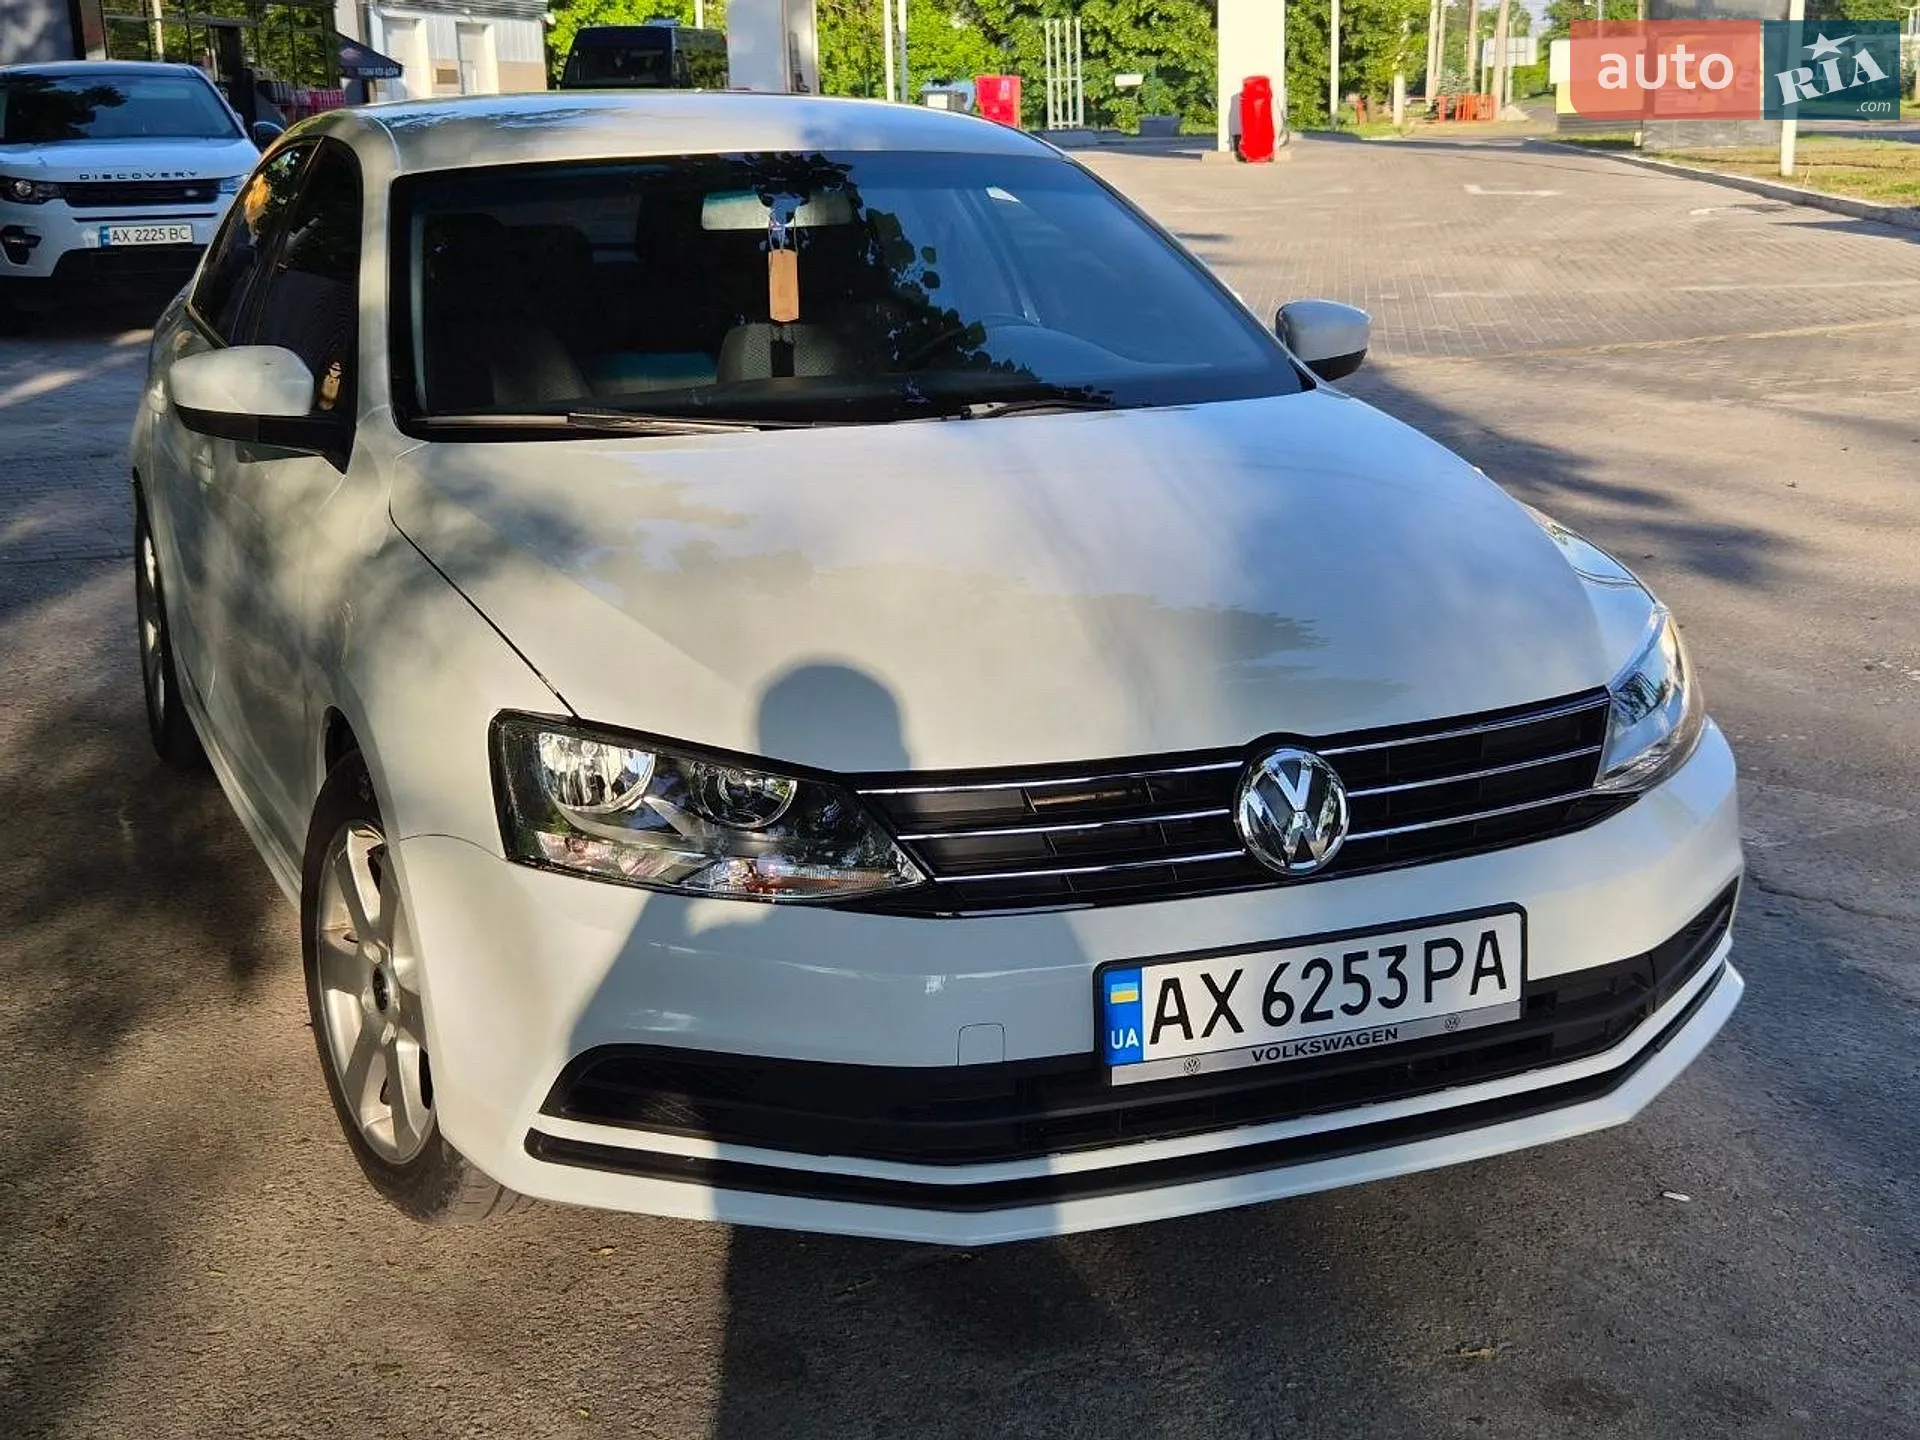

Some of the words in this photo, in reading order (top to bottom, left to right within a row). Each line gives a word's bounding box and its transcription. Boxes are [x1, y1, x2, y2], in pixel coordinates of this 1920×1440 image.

[79, 171, 198, 180] DISCOVERY
[112, 230, 130, 243] AX
[135, 229, 166, 242] 2225
[170, 228, 189, 240] BC
[1149, 968, 1245, 1045] AX
[1261, 944, 1409, 1027] 6253
[1423, 929, 1508, 1004] PA
[1111, 1027, 1140, 1049] UA
[1251, 1028, 1399, 1063] VOLKSWAGEN
